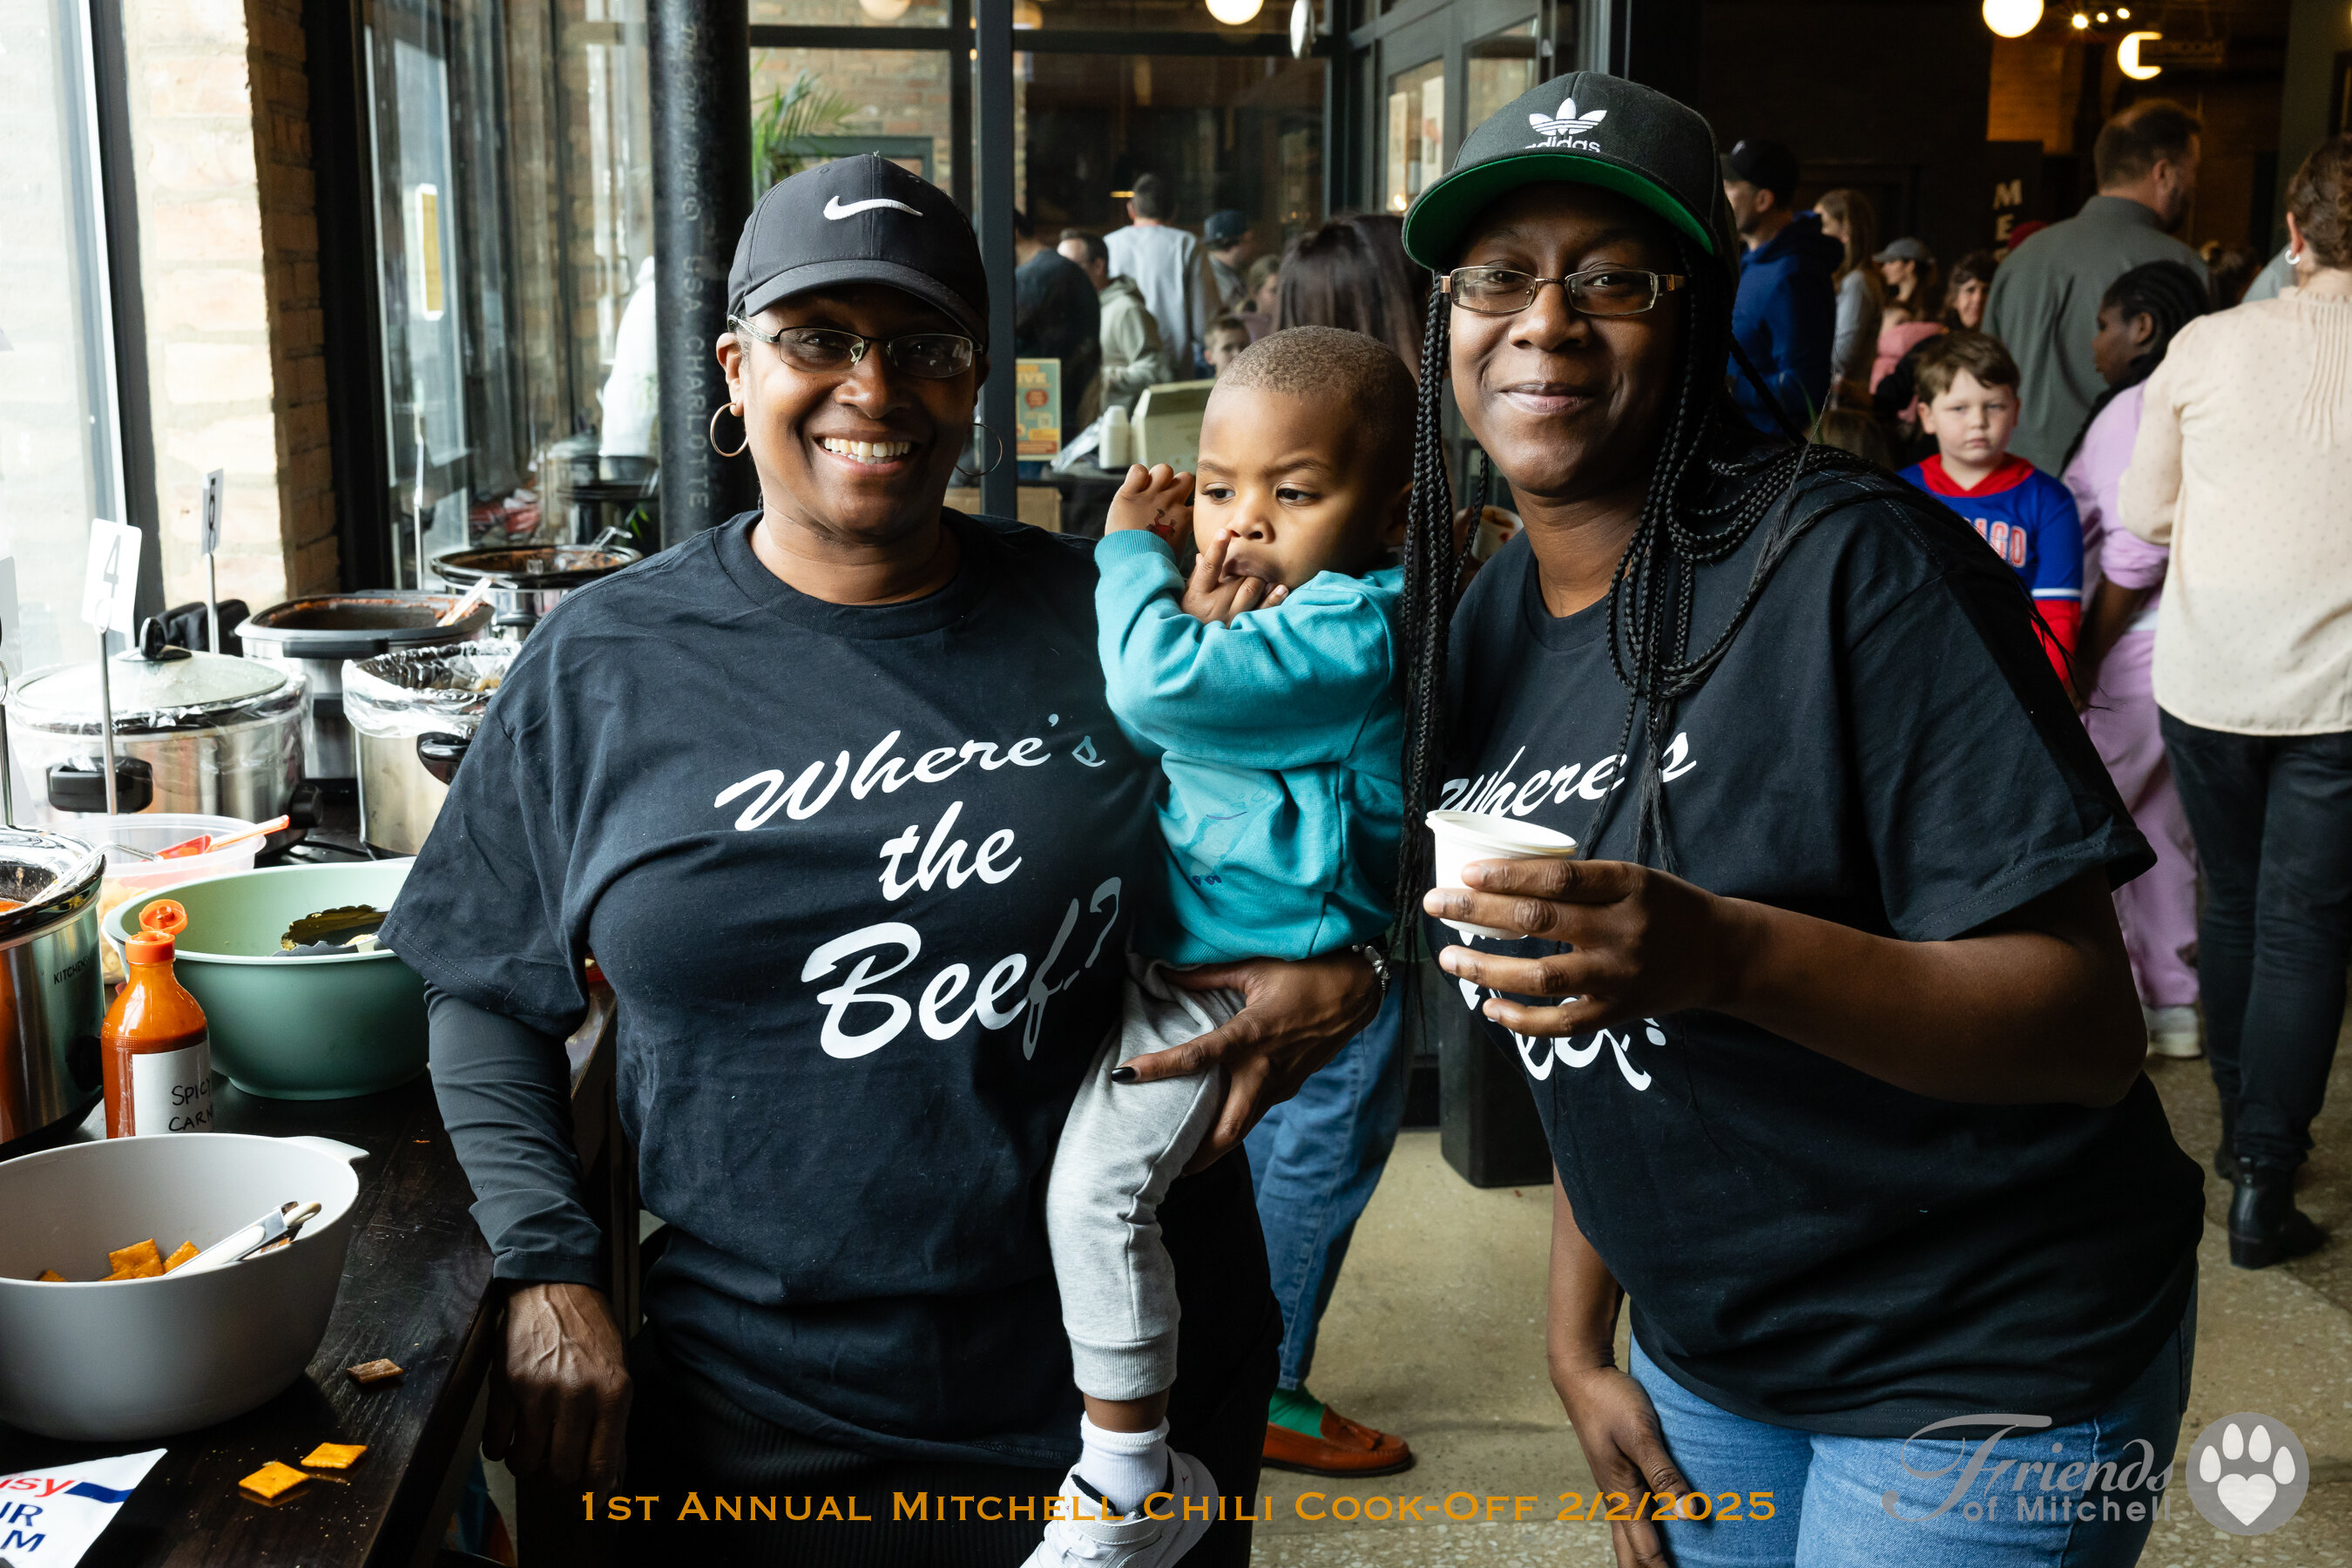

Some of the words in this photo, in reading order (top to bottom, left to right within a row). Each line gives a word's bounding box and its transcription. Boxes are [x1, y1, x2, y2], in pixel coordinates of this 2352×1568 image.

[681, 255, 703, 314] USA
[683, 335, 710, 509] CHARLOTTE
[103, 534, 122, 598] 4
[713, 713, 1106, 832] Where's
[878, 801, 1023, 902] the
[800, 875, 1123, 1061] Beef?
